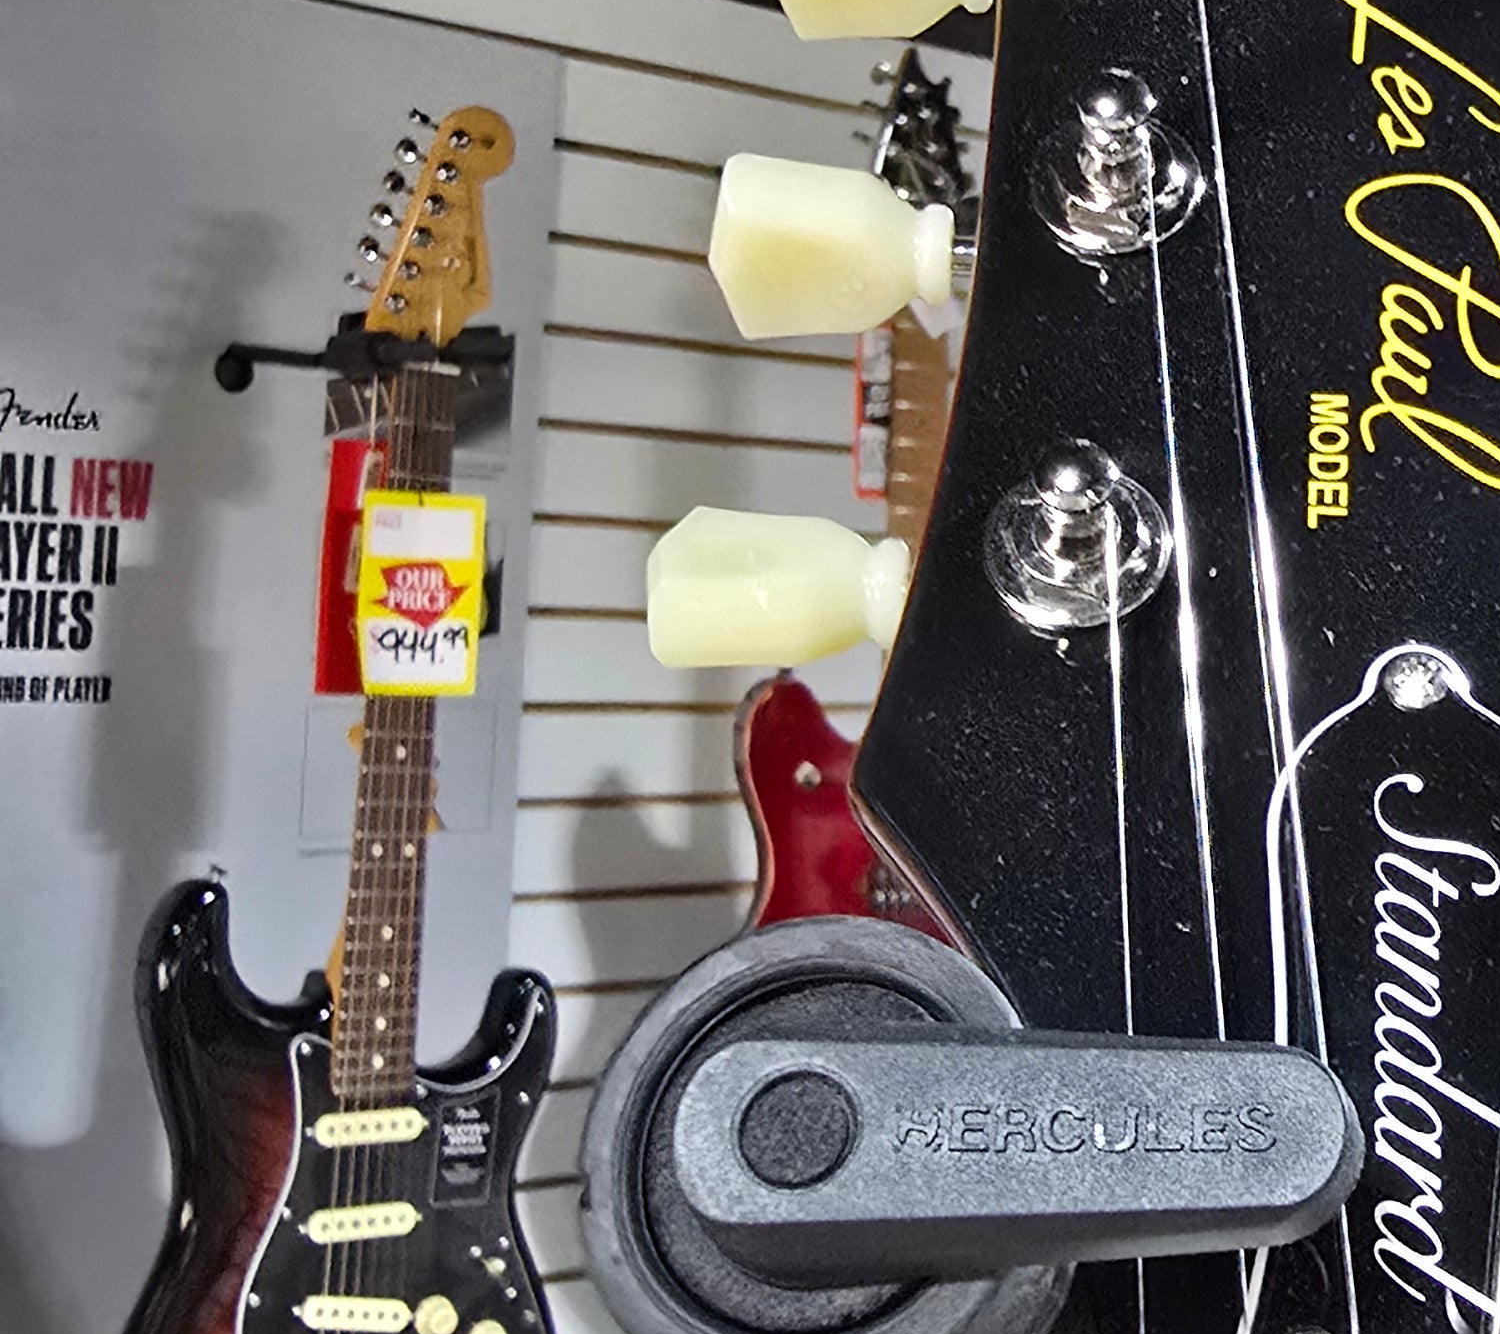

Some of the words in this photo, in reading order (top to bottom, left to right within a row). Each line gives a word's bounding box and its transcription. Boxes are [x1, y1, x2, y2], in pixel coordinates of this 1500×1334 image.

[0, 387, 101, 432] Fender
[0, 452, 59, 516] ALL
[70, 457, 154, 521] NEW
[1307, 392, 1349, 530] MODEL
[91, 525, 119, 586] II
[395, 566, 445, 589] OUR
[387, 588, 452, 612] PRICE
[895, 1102, 1278, 1155] HERCULES
